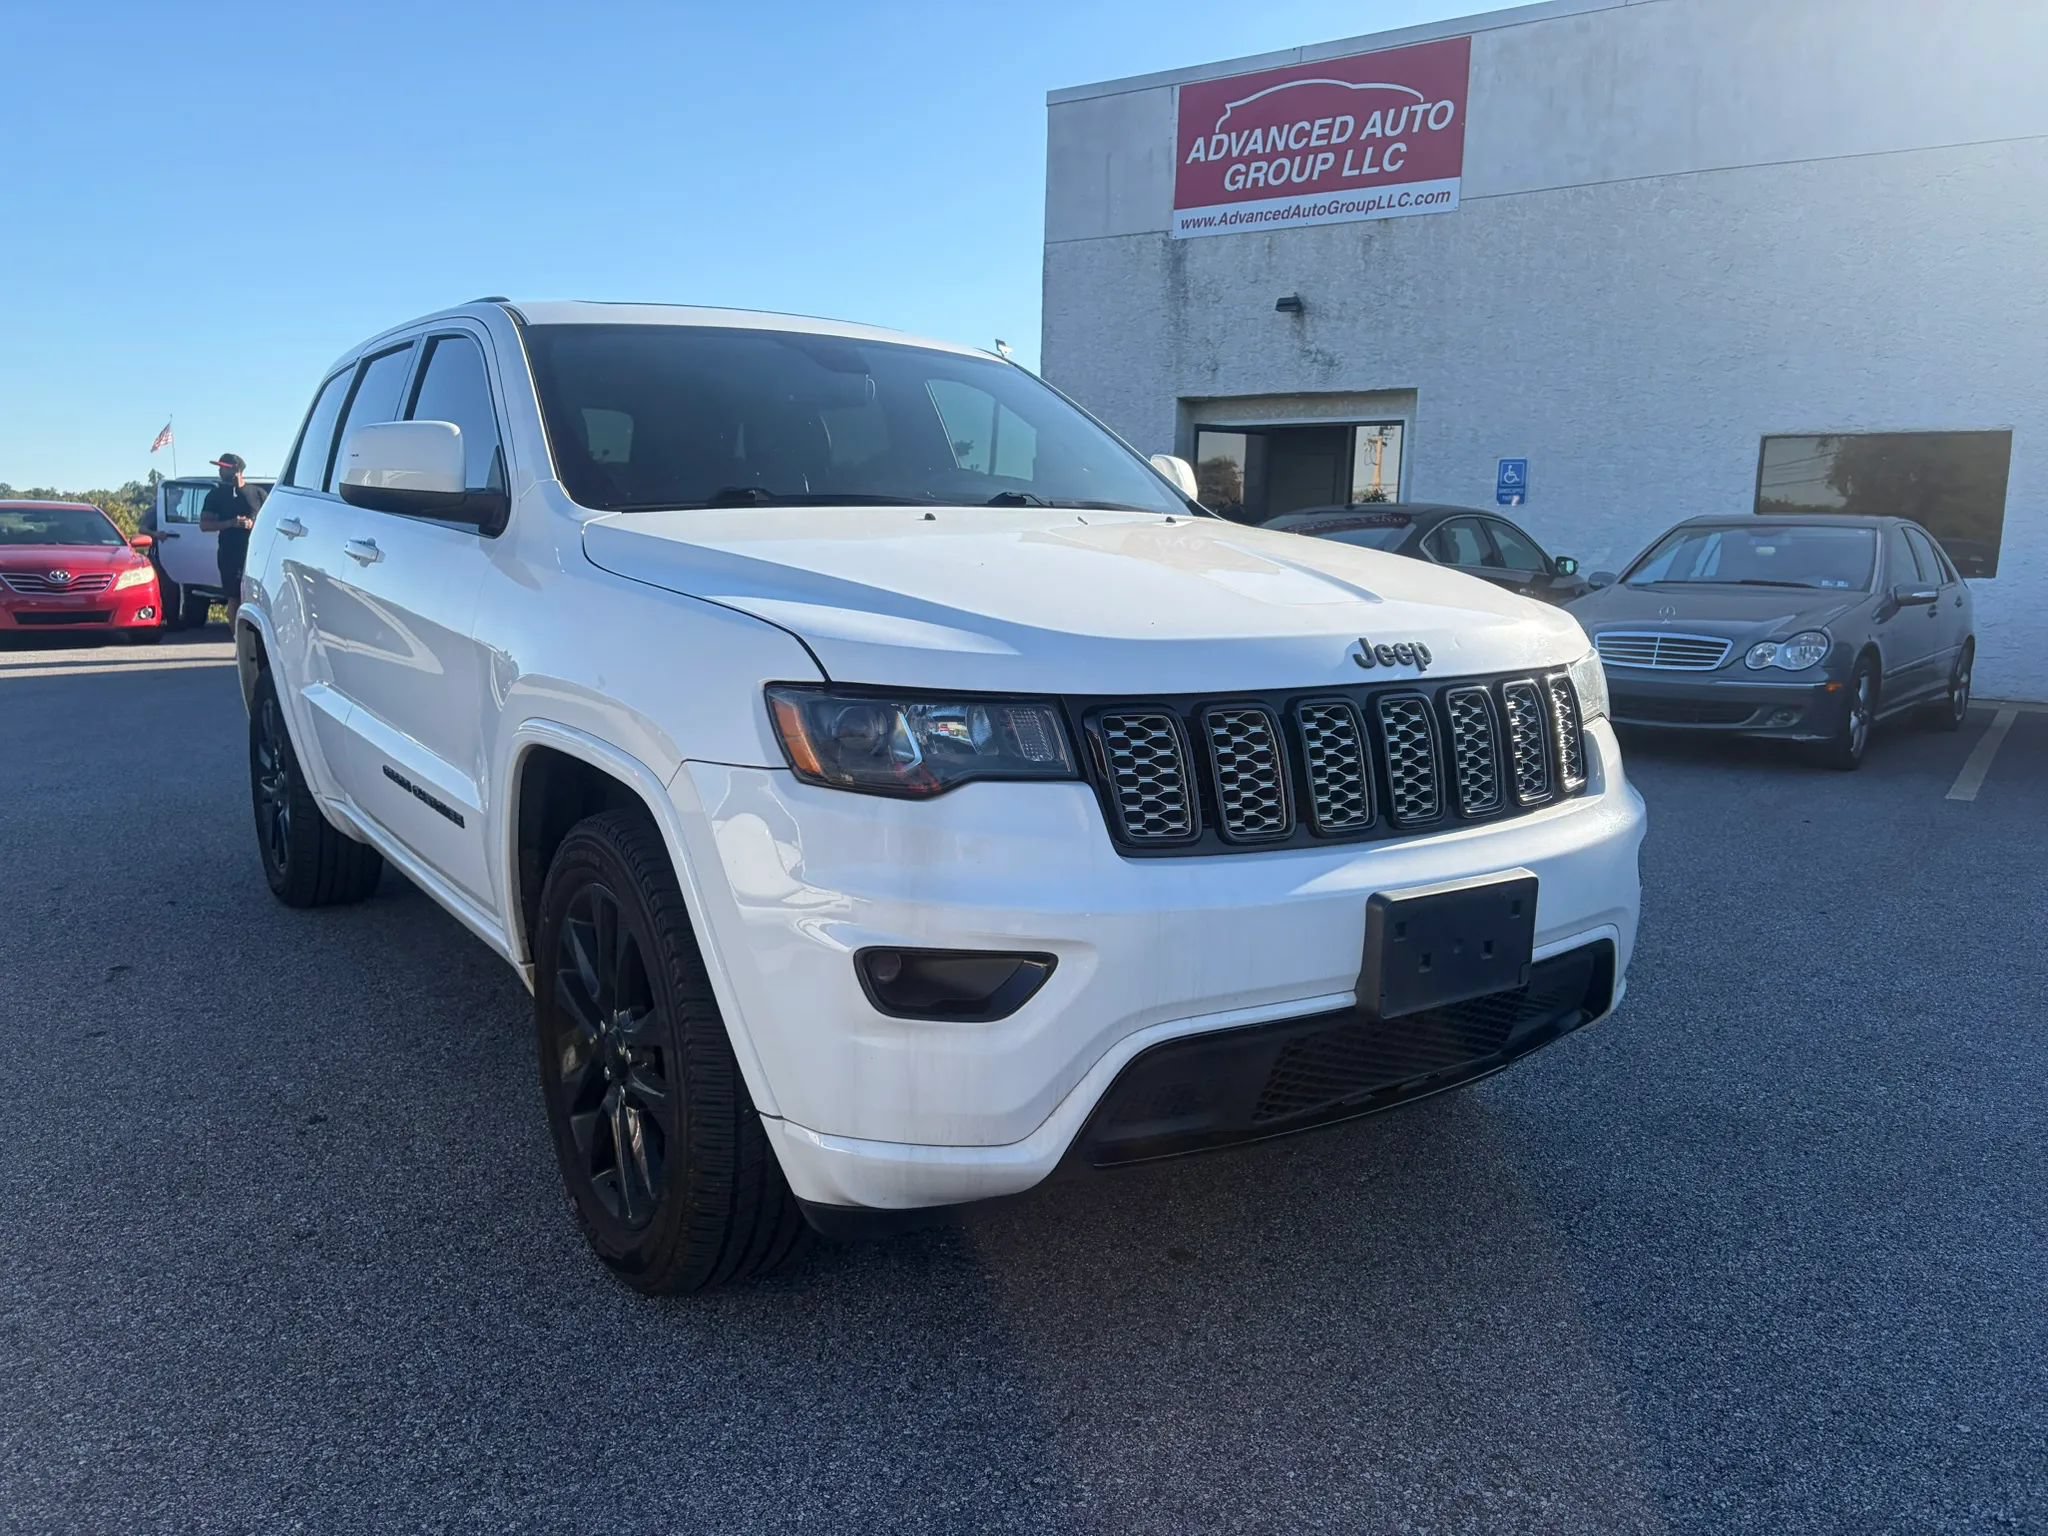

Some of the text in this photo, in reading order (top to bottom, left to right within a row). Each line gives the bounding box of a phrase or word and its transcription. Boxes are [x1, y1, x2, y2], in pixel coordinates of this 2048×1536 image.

[1186, 99, 1454, 164] ADVANCED AUTO
[1224, 142, 1407, 192] GROUP LLC
[1180, 189, 1451, 231] www.AdvancedAutoGroupLLC.com
[1352, 637, 1432, 672] Jeep
